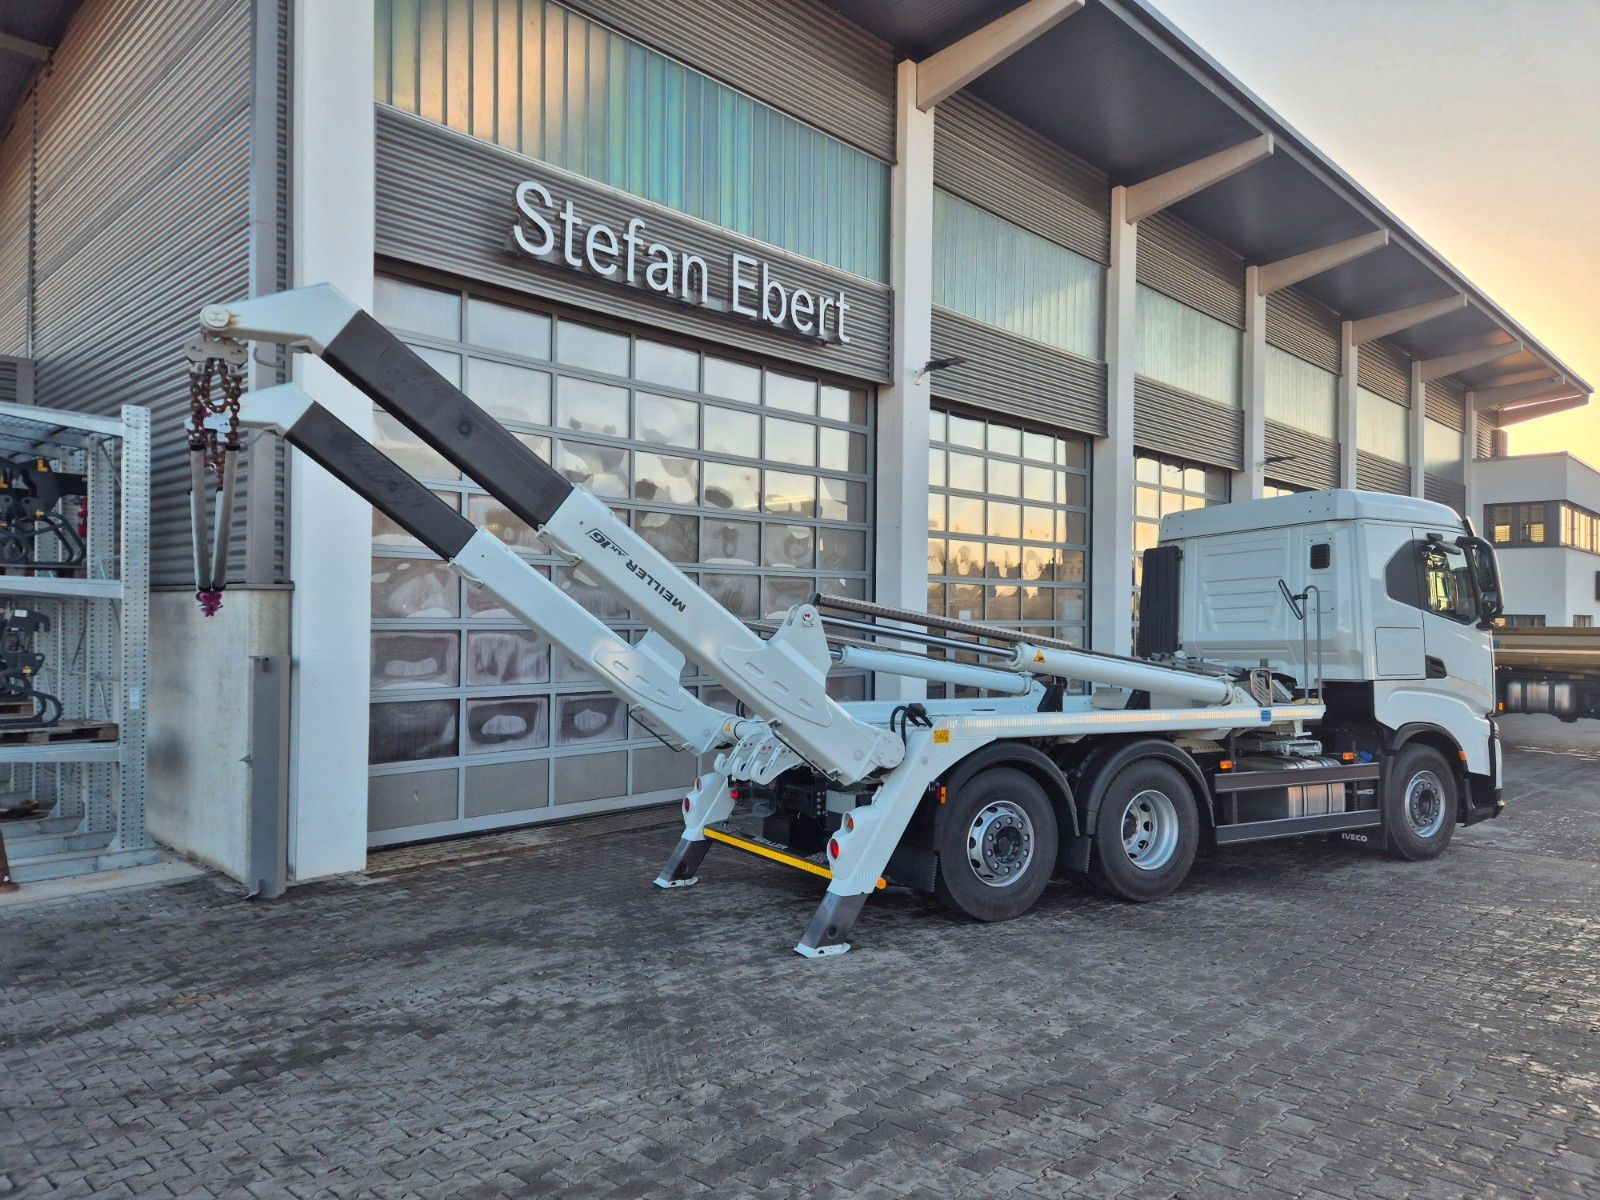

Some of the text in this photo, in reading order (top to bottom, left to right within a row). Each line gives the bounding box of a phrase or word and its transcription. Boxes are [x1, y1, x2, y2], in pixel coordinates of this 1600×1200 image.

[512, 180, 850, 343] Stefan Ebert
[625, 559, 687, 613] MEILLER
[1341, 832, 1368, 843] IVECO
